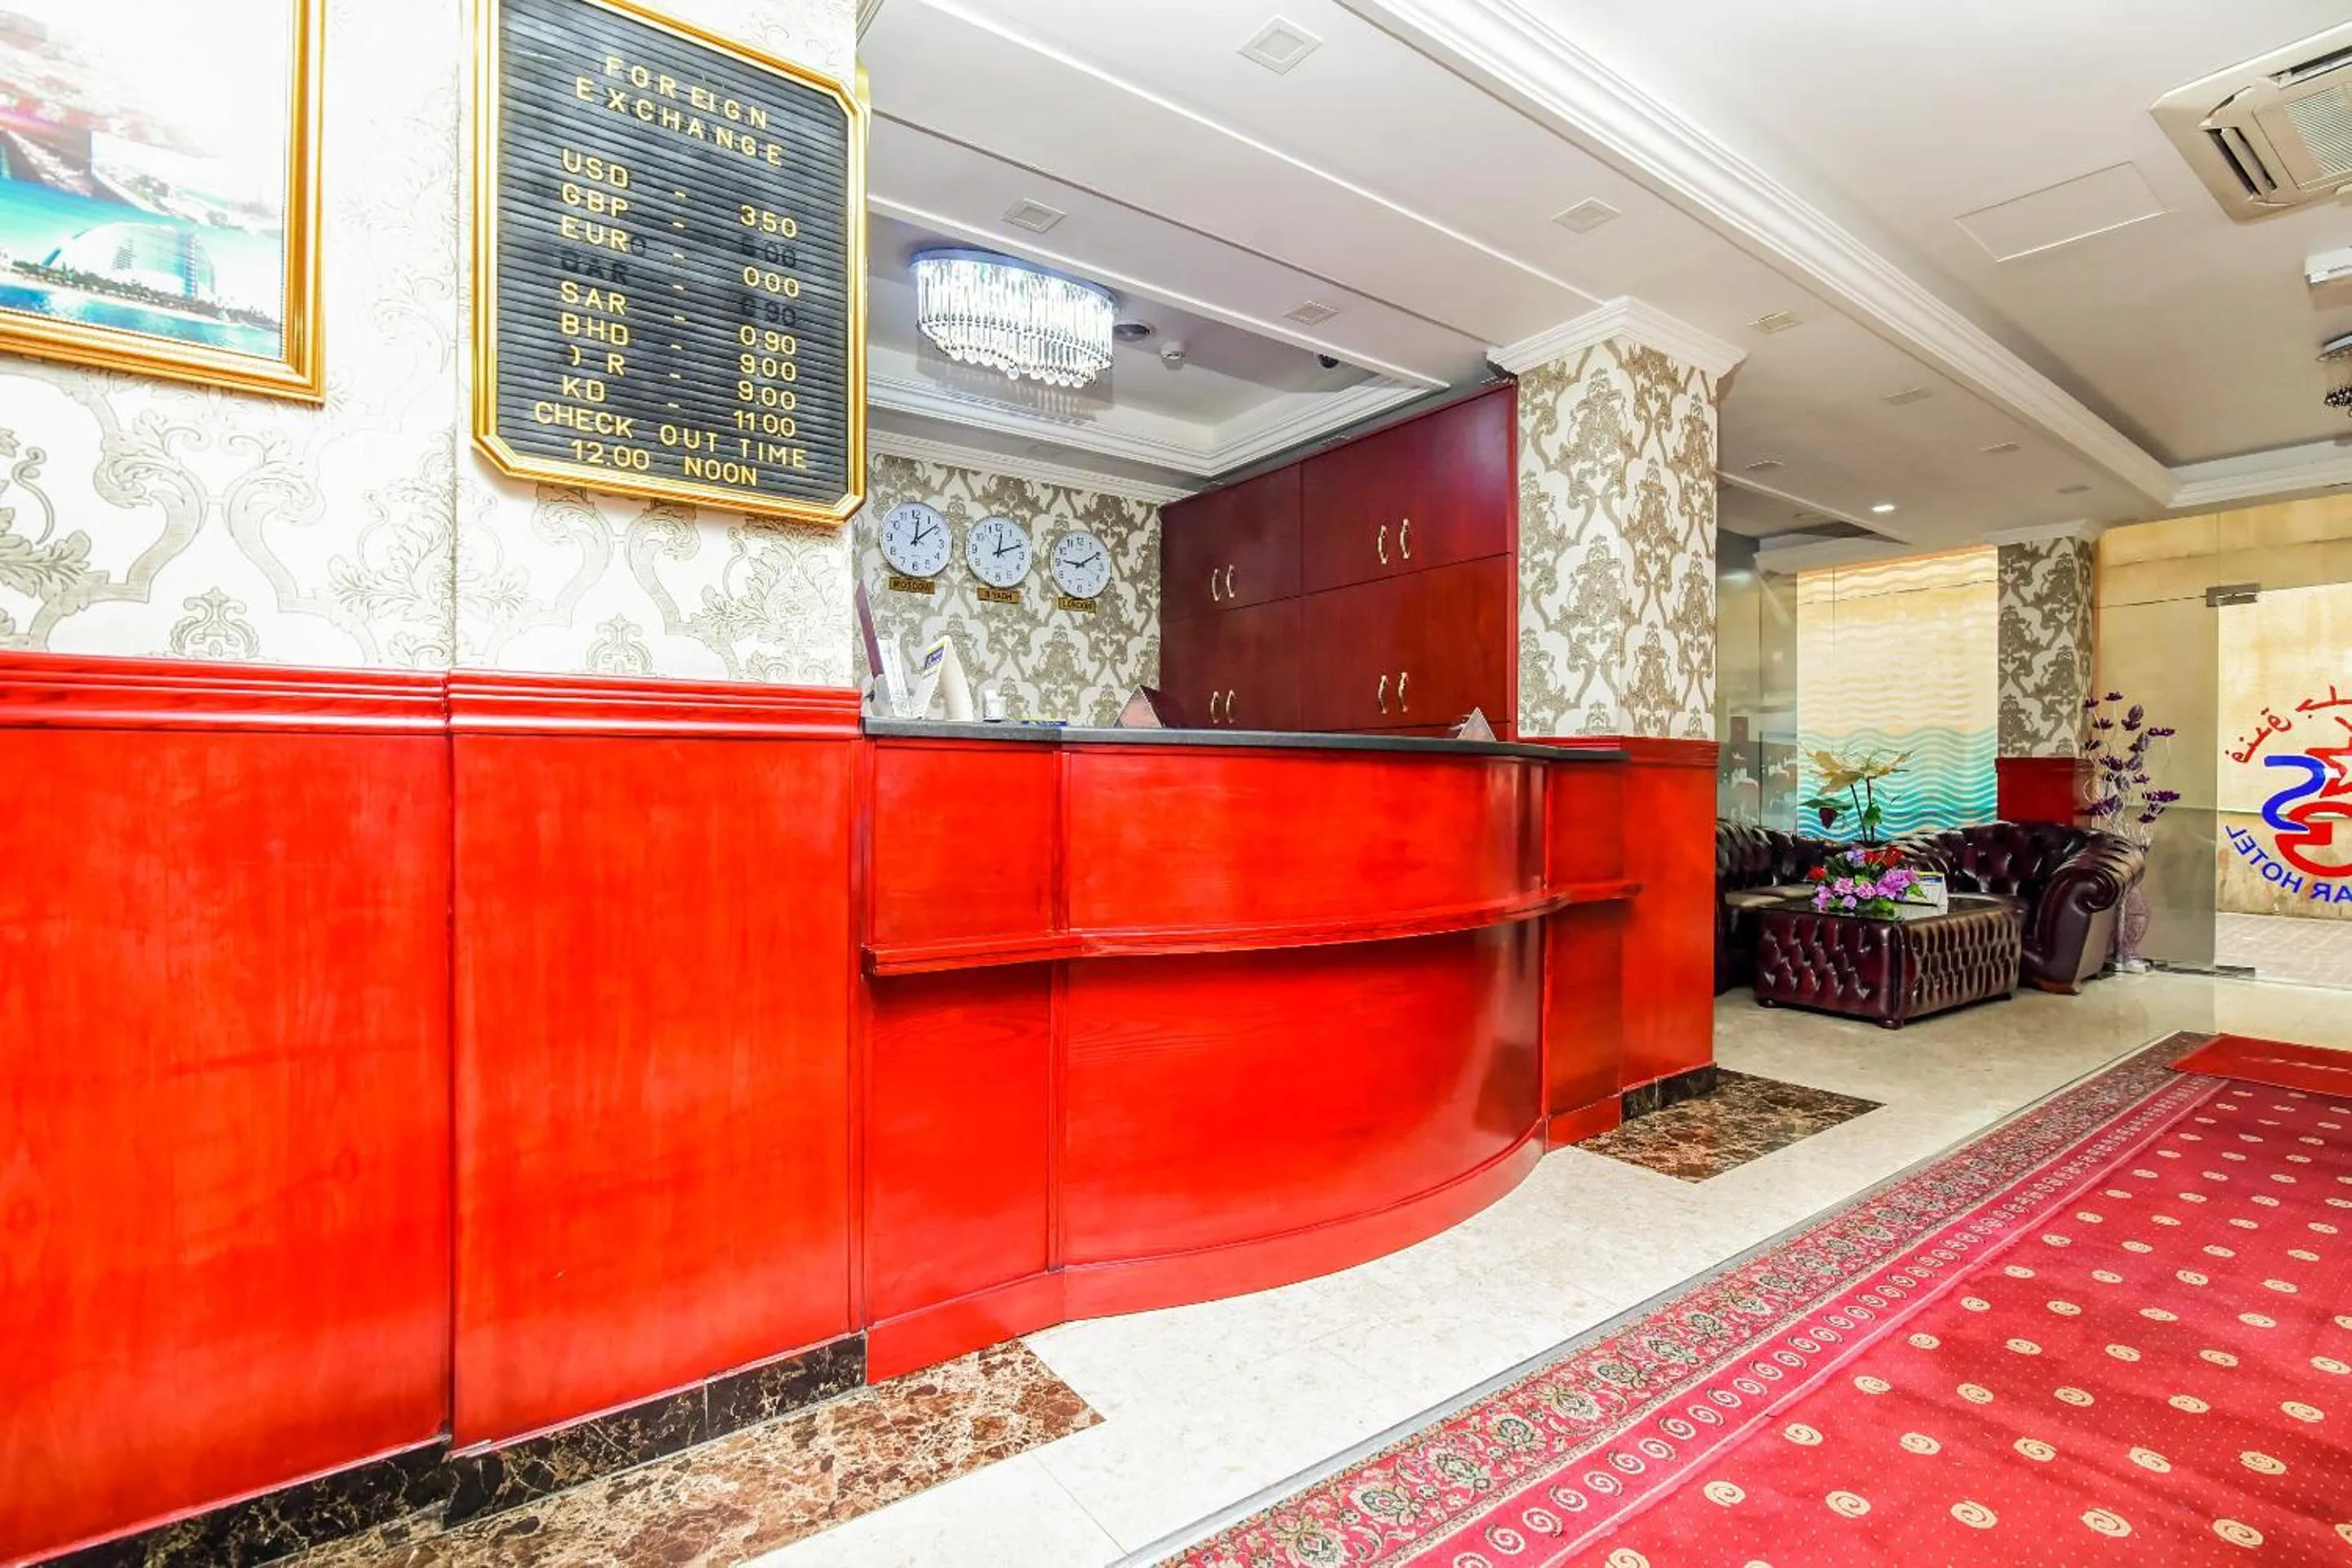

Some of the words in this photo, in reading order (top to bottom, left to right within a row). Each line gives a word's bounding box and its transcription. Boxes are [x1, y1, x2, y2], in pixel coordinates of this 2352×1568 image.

[606, 56, 768, 130] FOREIGN
[576, 76, 783, 167] EXCHANGE
[561, 148, 629, 189] USD
[561, 184, 629, 217] GBP
[560, 281, 627, 316] SAR
[561, 312, 629, 346] BHD
[562, 375, 605, 403] KD
[534, 401, 634, 439] CHECK
[659, 424, 719, 453] OUT
[741, 439, 808, 470] TIME
[571, 439, 650, 471] 12.00
[684, 457, 757, 488] NOON
[985, 590, 1013, 602] RYADH
[1062, 600, 1093, 611] LONDON
